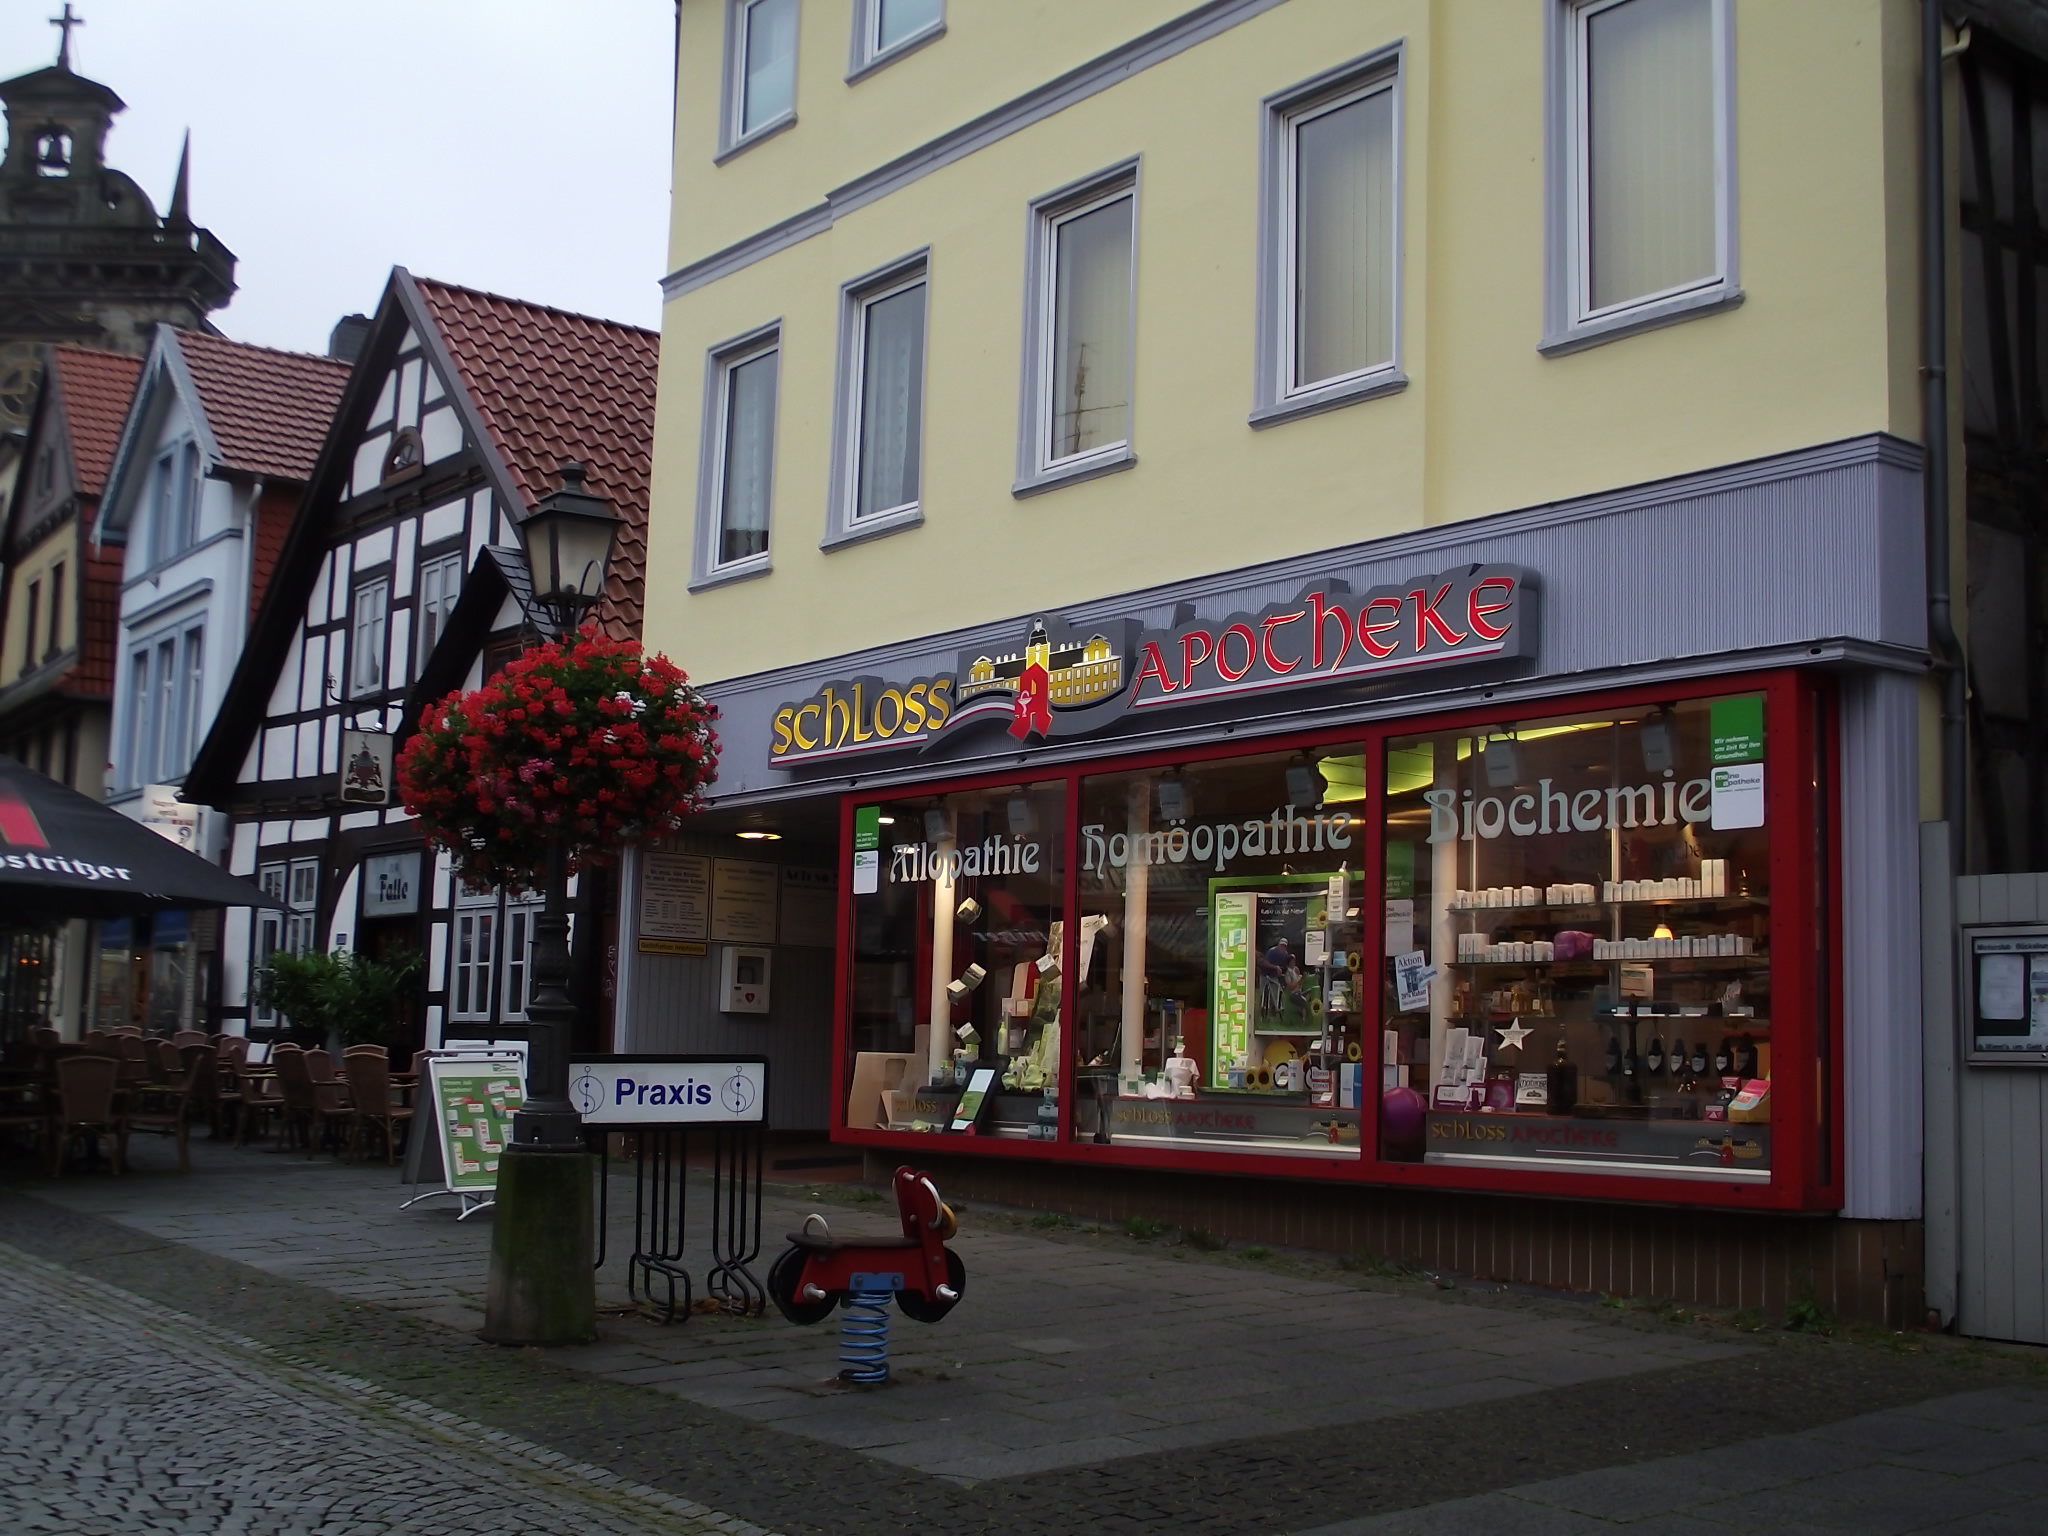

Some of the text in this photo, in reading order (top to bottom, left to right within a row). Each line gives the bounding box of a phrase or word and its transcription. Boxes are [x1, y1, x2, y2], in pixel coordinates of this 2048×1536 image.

[1132, 576, 1517, 699] APOTHEKE
[1725, 735, 1749, 743] nehmen
[1722, 777, 1761, 787] apotheke
[1423, 769, 1712, 843] Biochemie
[1081, 804, 1352, 879] Homöopathie
[0, 851, 133, 881] stritzer
[890, 834, 1040, 889] Allopathie
[1398, 956, 1422, 968] Aktion
[616, 1079, 711, 1105] Praxis
